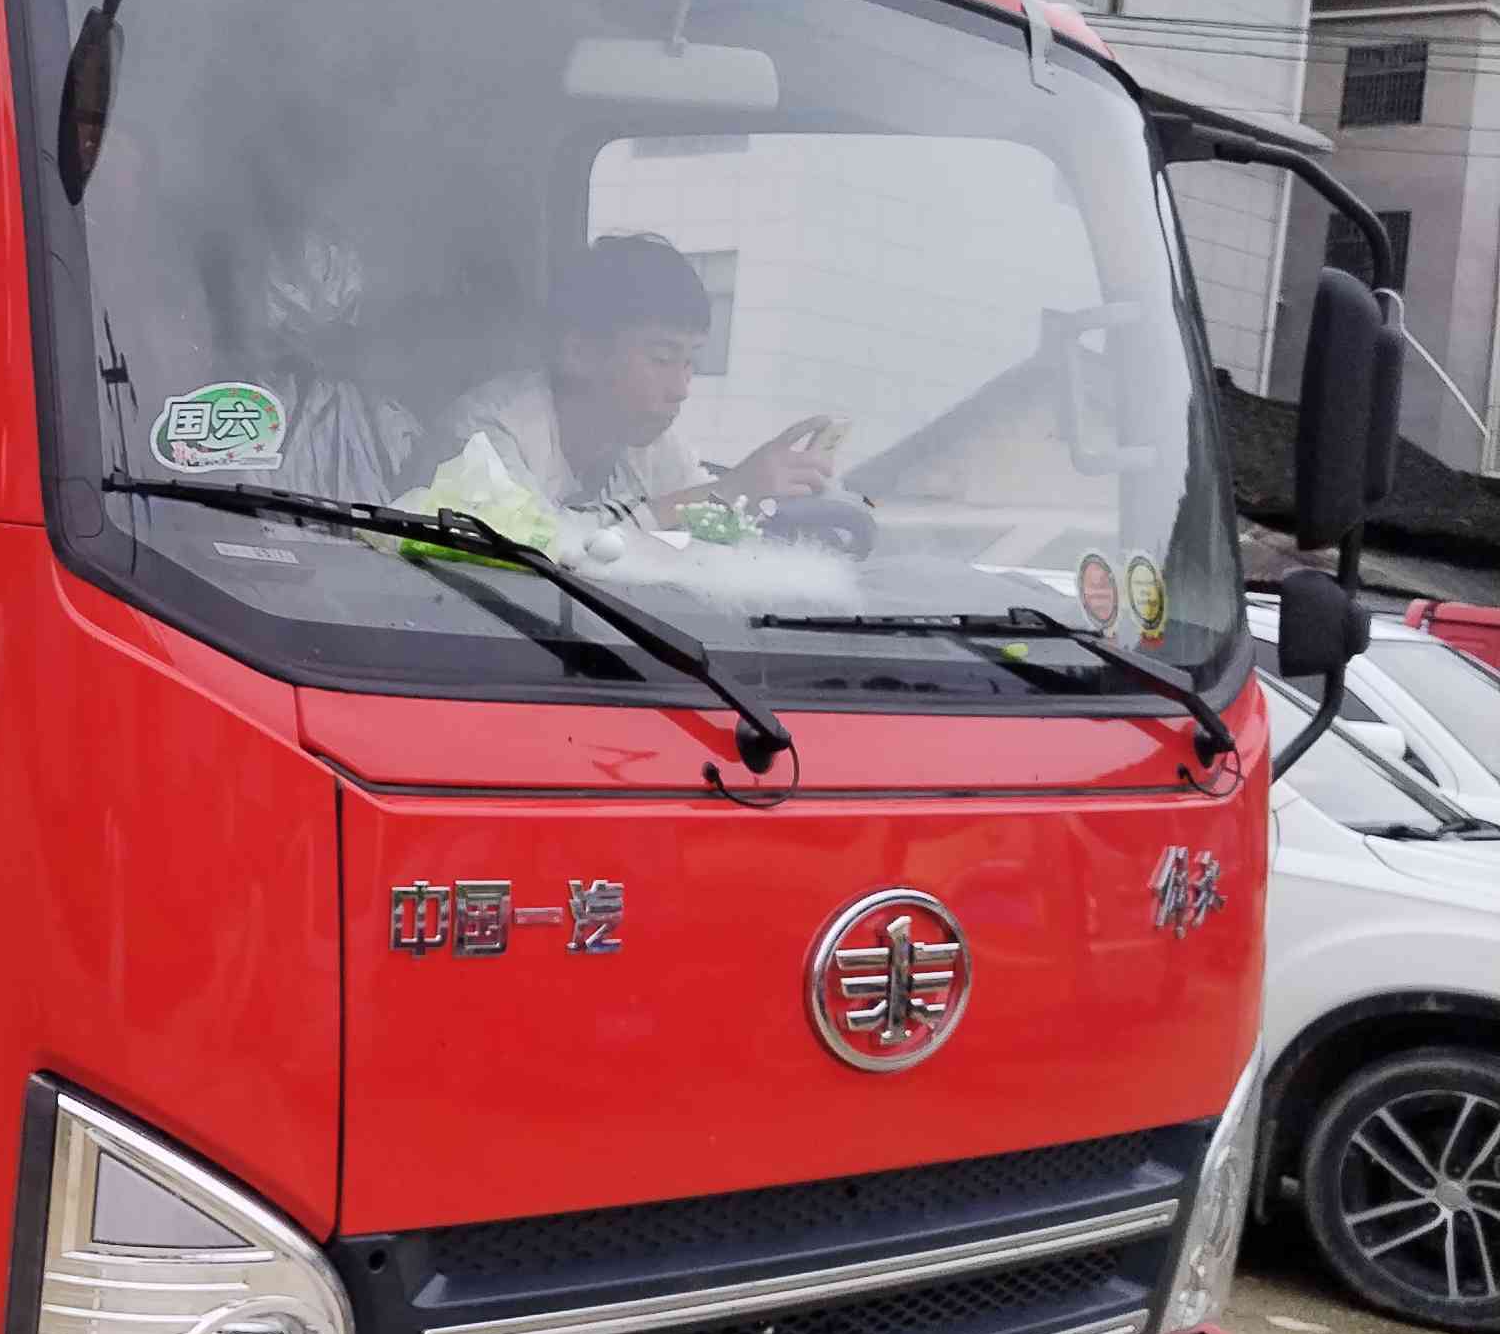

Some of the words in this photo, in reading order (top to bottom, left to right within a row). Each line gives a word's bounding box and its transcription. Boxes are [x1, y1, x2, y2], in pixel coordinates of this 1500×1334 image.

[167, 401, 262, 441] 国六
[390, 880, 624, 958] 中国一汽
